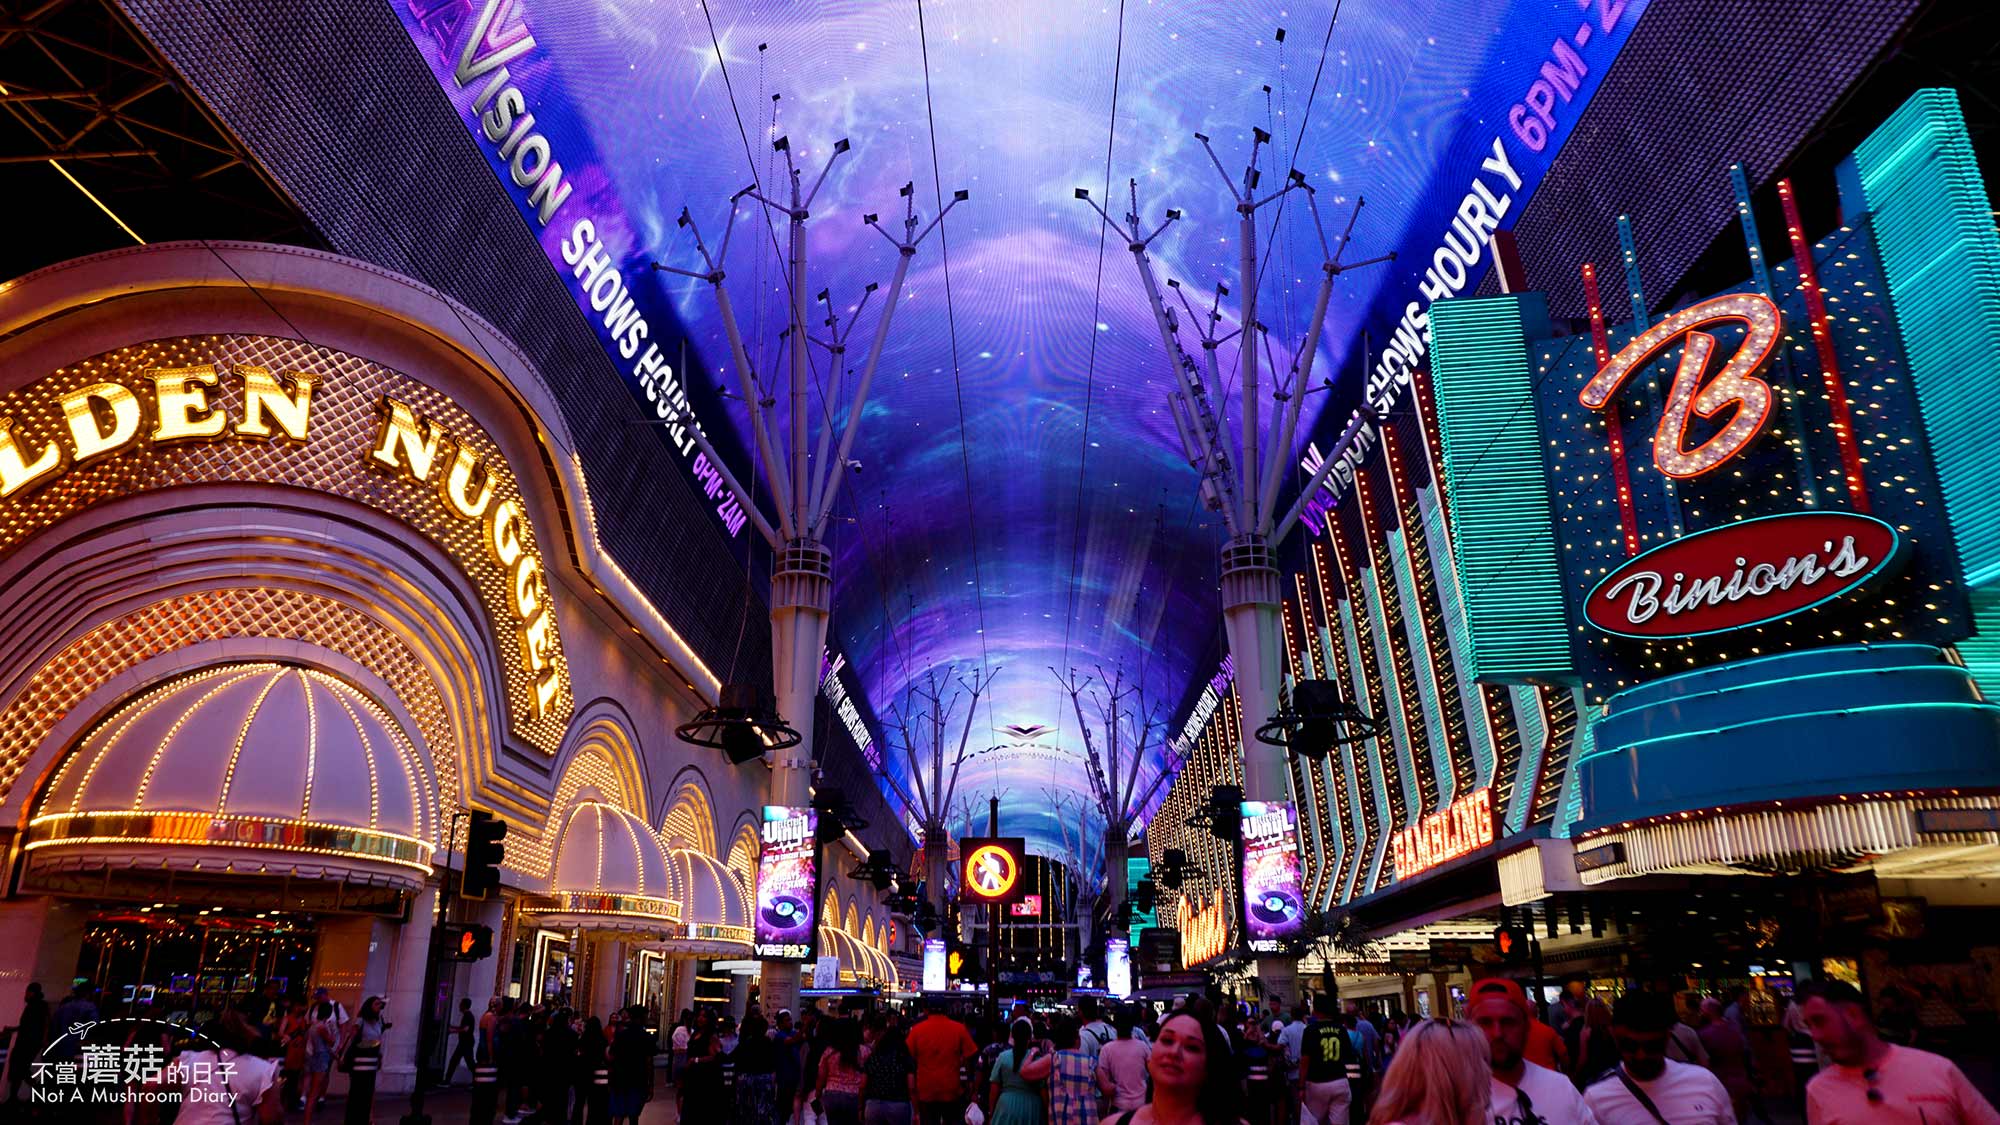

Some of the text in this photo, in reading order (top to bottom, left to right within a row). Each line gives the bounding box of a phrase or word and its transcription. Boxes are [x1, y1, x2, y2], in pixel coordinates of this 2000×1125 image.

[562, 218, 648, 359] SHOWS
[1367, 301, 1432, 419] SHOWS
[1419, 136, 1523, 300] HOURLY
[1579, 293, 1781, 478] B
[369, 394, 560, 720] NUGGET
[1606, 536, 1868, 623] Binion's
[837, 696, 859, 732] SHOWS
[1393, 786, 1493, 880] GAMBLING
[754, 944, 783, 956] VIBE
[1320, 1037, 1340, 1062] 10
